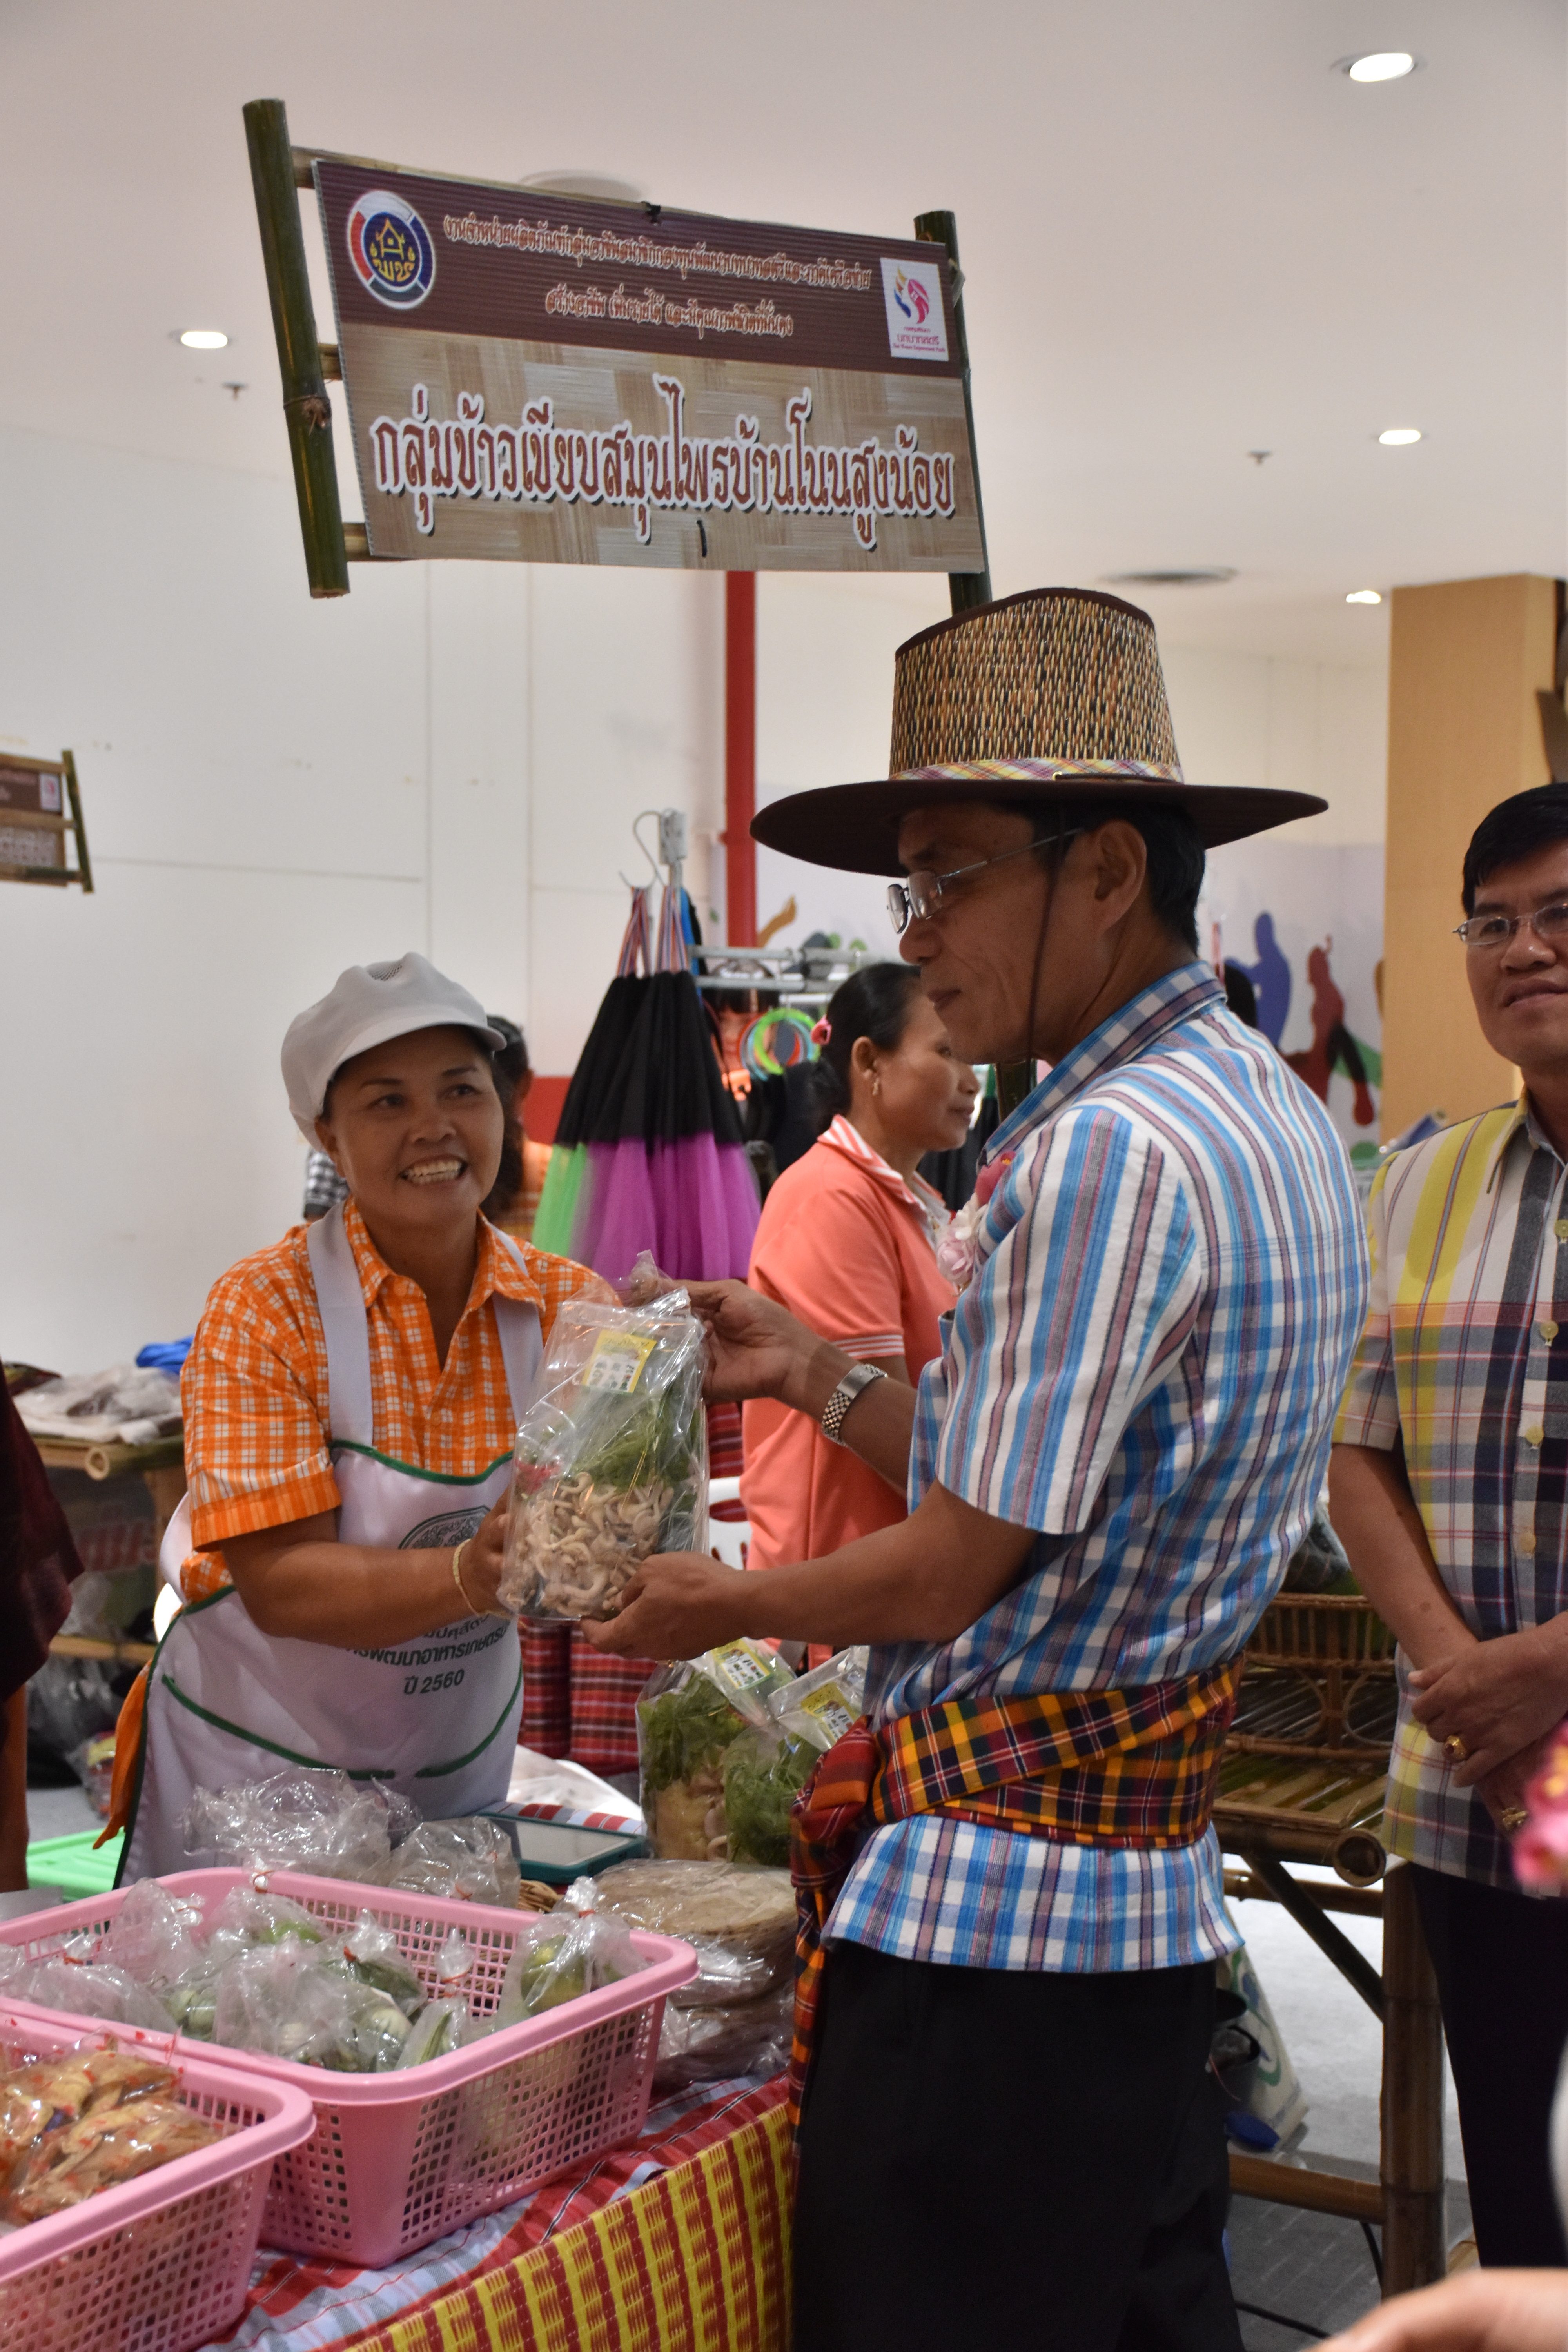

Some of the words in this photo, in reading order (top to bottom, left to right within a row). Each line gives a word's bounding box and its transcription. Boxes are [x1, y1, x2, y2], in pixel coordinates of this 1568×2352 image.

[545, 283, 606, 317] สร้างอาชีพ
[608, 283, 664, 325] เพิ่มรายได้
[404, 1674, 418, 1695] ปี
[420, 1669, 465, 1694] 2560
